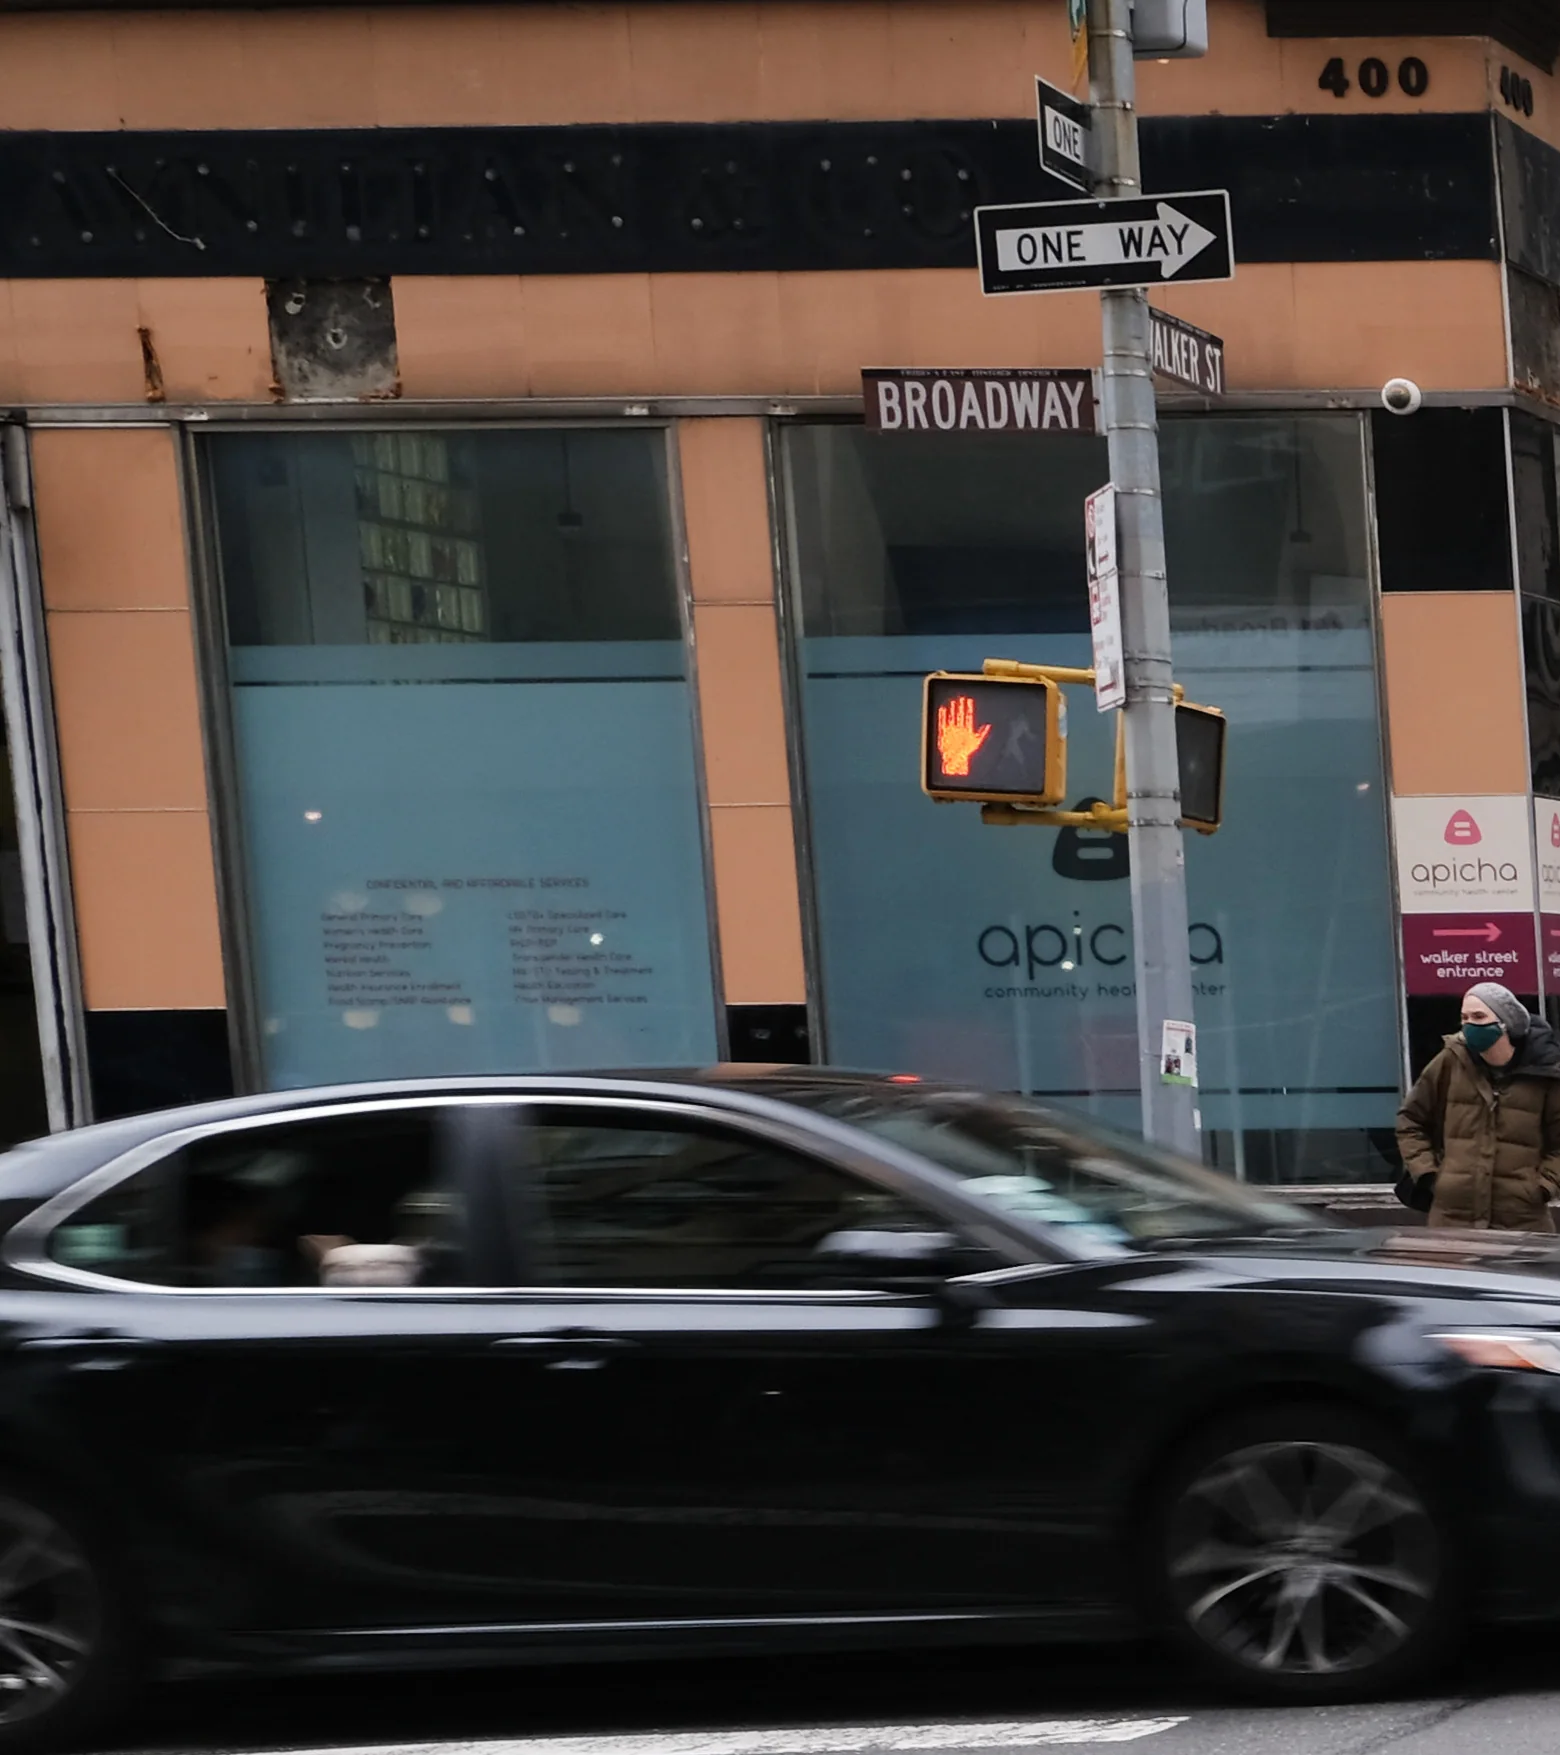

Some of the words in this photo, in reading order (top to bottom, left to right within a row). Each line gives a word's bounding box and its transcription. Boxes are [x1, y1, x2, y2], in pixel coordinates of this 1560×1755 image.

[1318, 57, 1429, 98] 400
[1053, 116, 1081, 160] ONE
[1017, 230, 1086, 265] ONE
[1119, 224, 1189, 259] WAY
[1205, 343, 1221, 394] ST
[877, 379, 1085, 430] BROADWAY
[1411, 857, 1518, 888] apicha
[978, 910, 1223, 980] apica
[1420, 950, 1469, 964] walker
[1475, 950, 1518, 964] street
[985, 984, 1089, 1001] community
[1097, 982, 1137, 998] heal
[1437, 966, 1504, 978] entrance
